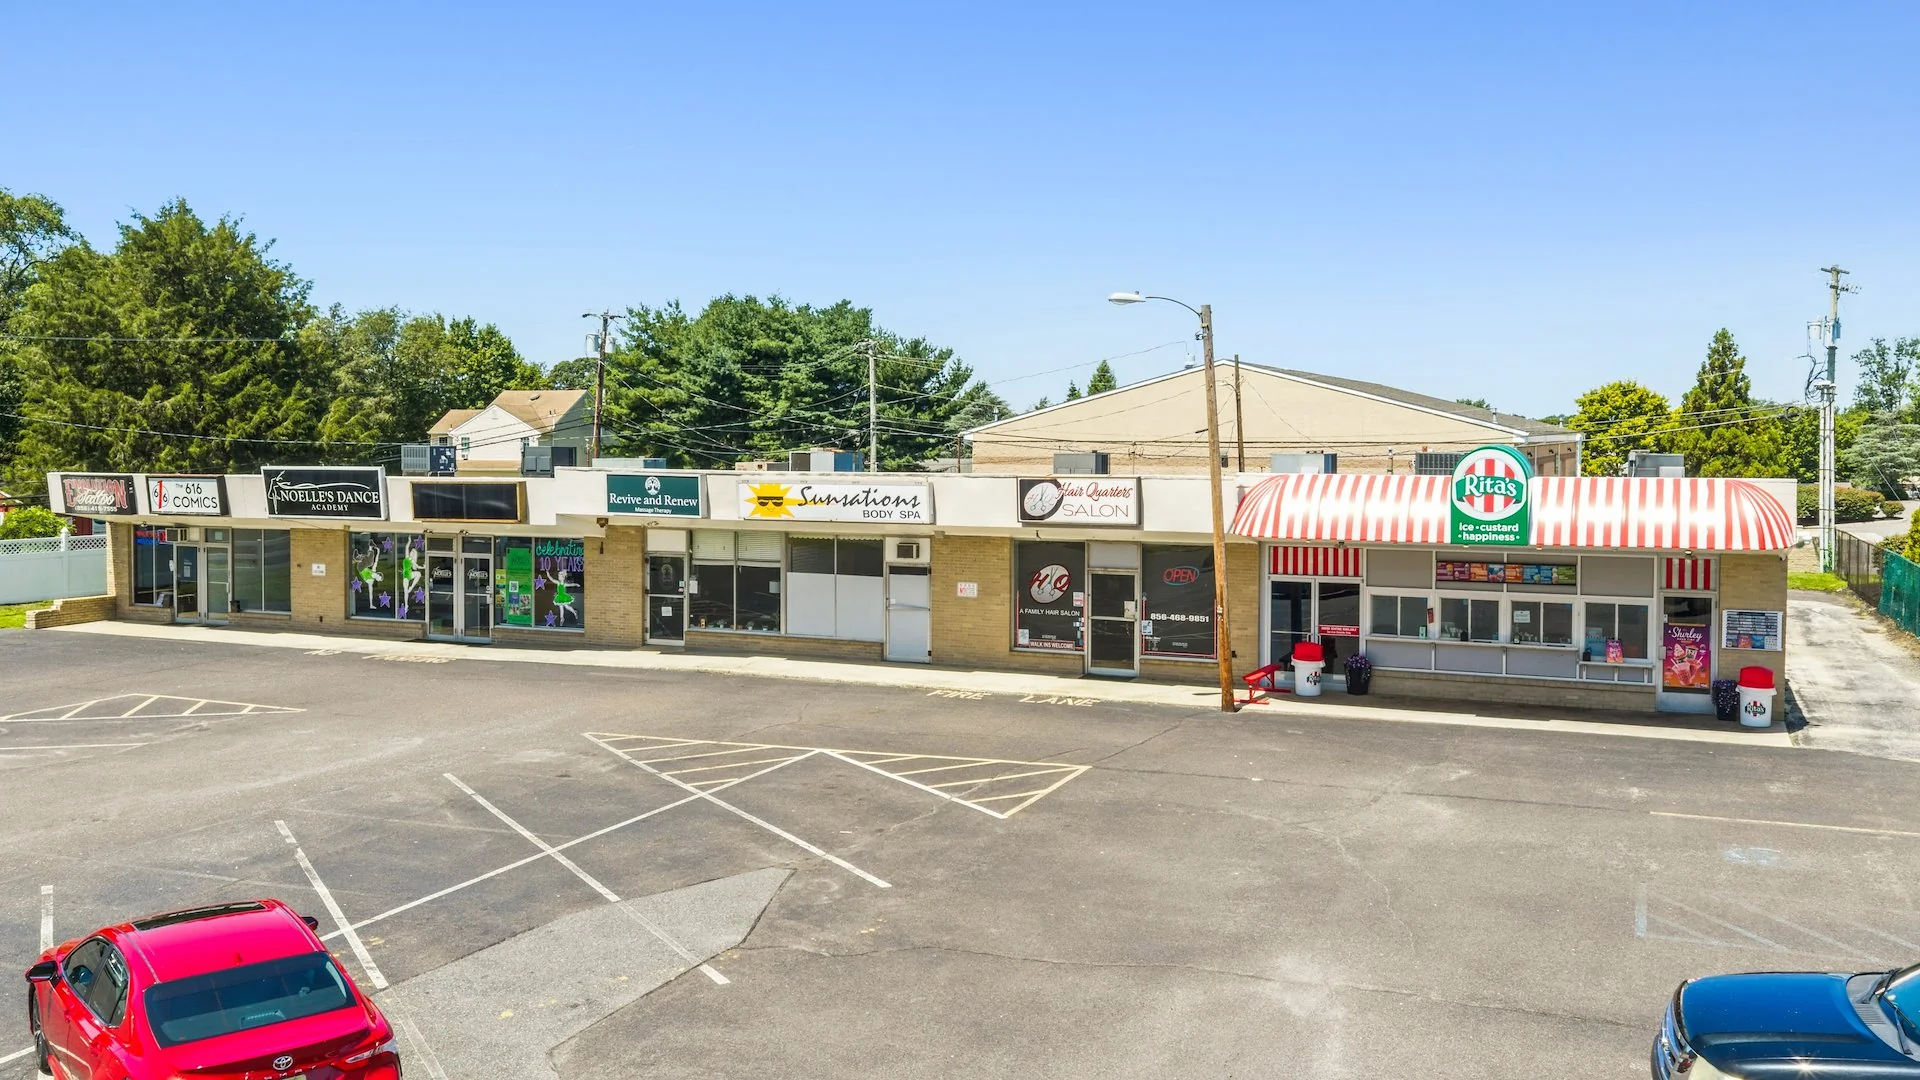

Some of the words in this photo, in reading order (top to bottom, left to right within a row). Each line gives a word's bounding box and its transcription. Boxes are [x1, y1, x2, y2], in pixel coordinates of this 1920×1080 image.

[185, 483, 203, 494] 616
[1055, 482, 1084, 499] Hair
[1086, 482, 1133, 501] Quarters
[1464, 474, 1517, 496] Rita's
[75, 488, 115, 505] Tattoo
[173, 497, 218, 508] COMICS
[280, 490, 334, 502] NOELLE'S
[337, 491, 380, 503] DANCE
[609, 493, 641, 505] Revive
[643, 495, 662, 505] and
[664, 495, 698, 507] Renew
[798, 486, 920, 507] Sunsations
[863, 510, 893, 519] BODY
[900, 511, 920, 519] SPA
[1062, 504, 1128, 517] SALON
[1459, 522, 1474, 531] ice
[1480, 523, 1519, 532] custard
[1462, 532, 1515, 541] happiness
[540, 556, 551, 571] 10
[1163, 568, 1196, 583] OPEN
[1671, 627, 1704, 642] Shirley
